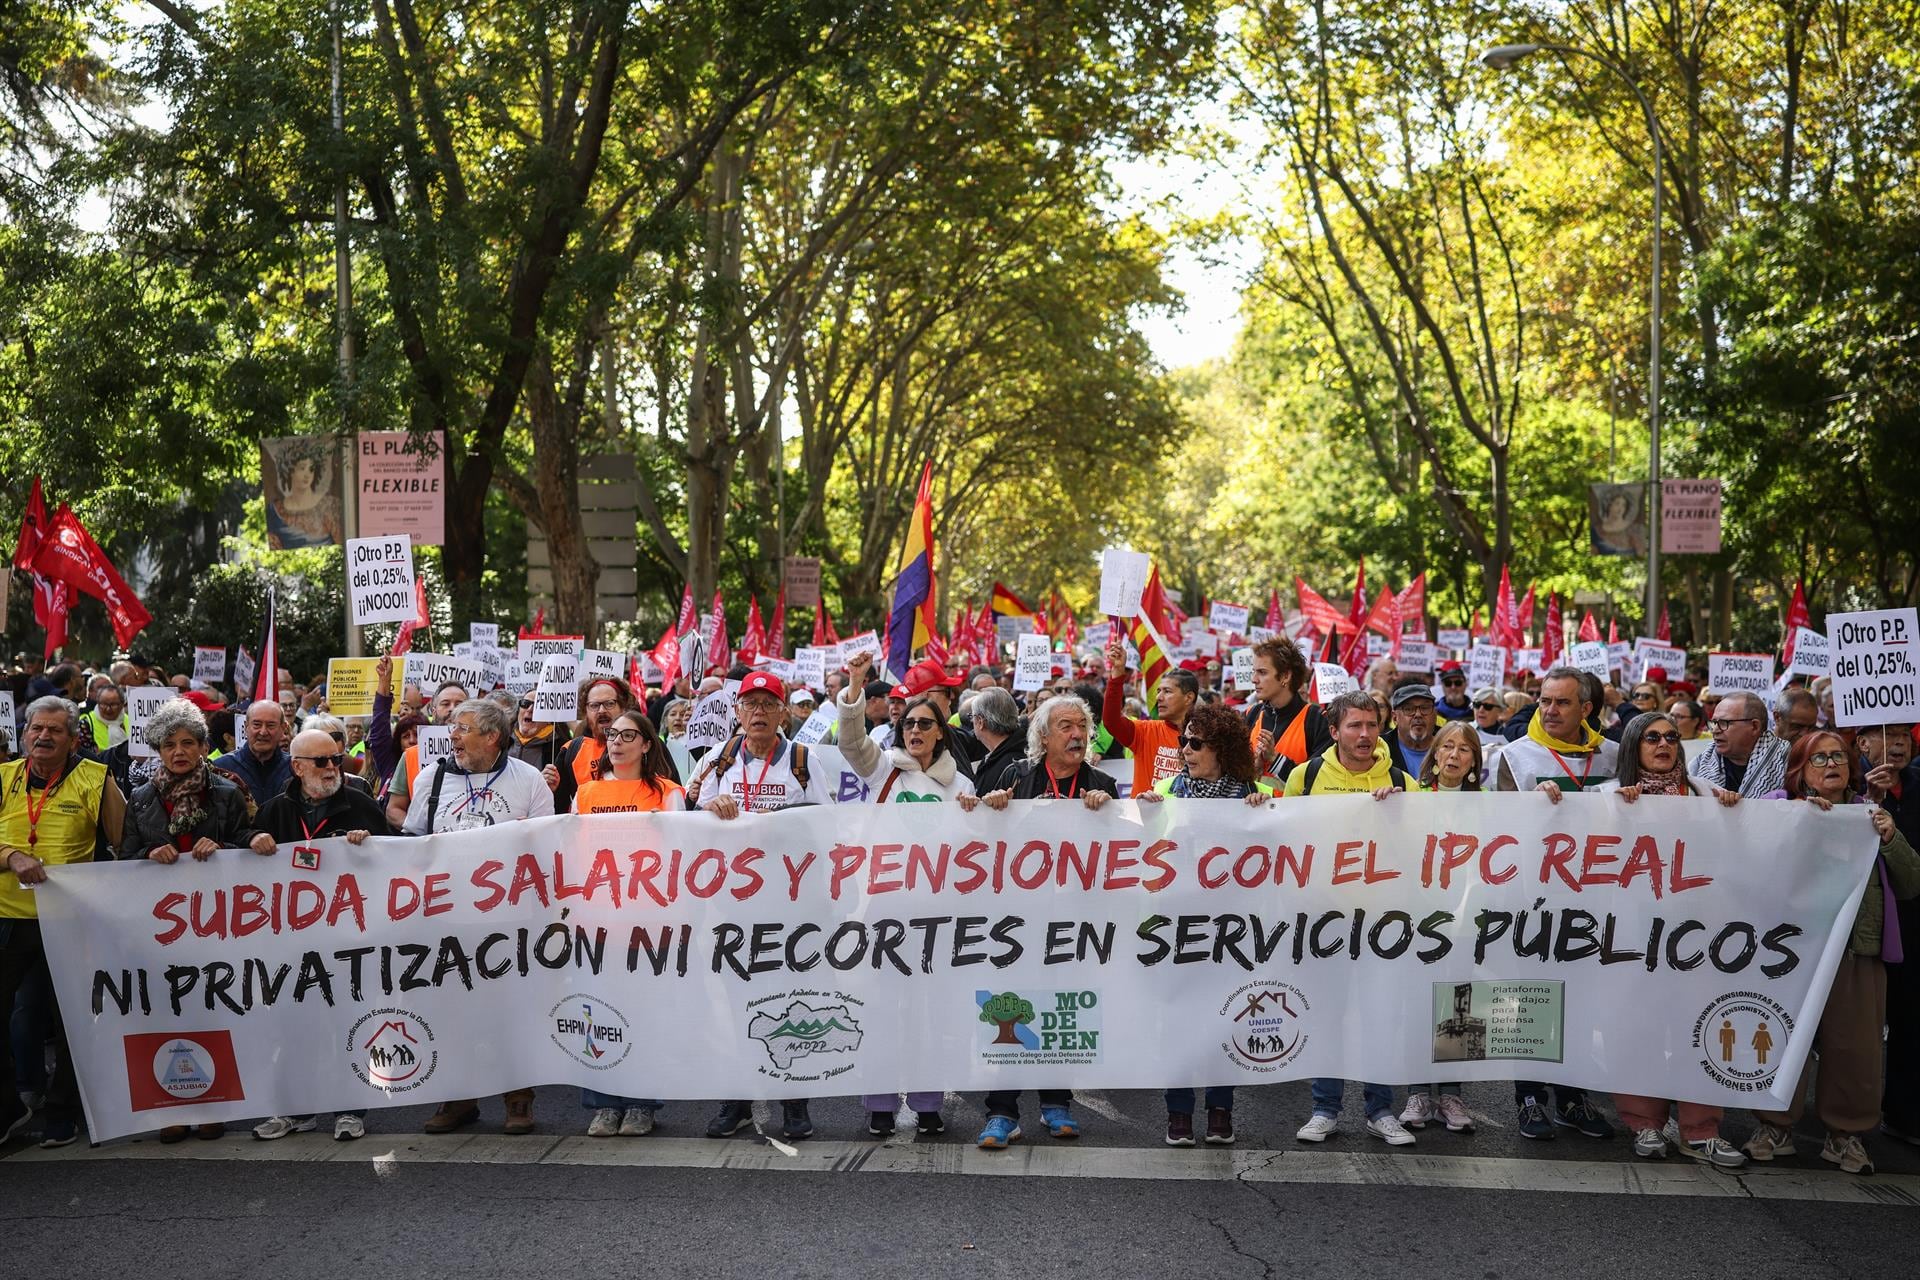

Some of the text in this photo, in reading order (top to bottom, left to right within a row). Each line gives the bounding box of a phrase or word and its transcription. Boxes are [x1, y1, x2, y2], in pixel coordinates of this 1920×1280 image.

[363, 441, 378, 456] EL
[363, 478, 439, 493] FLEXIBLE
[1665, 484, 1719, 495] EL PLANO
[1664, 508, 1717, 520] FLEXIBLE
[353, 542, 405, 567] ¡Otro P.P.
[353, 567, 410, 588] del 0,25%,
[358, 592, 409, 617] ¡¡NOOO!!
[1836, 618, 1909, 651] ¡Otro P.P.
[530, 641, 574, 658] ¡PENSIONES
[595, 655, 614, 672] PAN,
[1721, 658, 1763, 672] ¡PENSIONES
[1836, 650, 1916, 679] del 0,25%,
[423, 663, 482, 690] JUSTICIA!
[541, 665, 575, 686] ¡BLINDAR
[1713, 676, 1769, 691] GARANTIZADAS!
[536, 692, 577, 710] PENSIONES!
[1843, 683, 1916, 716] ¡¡NOOO!!
[688, 721, 728, 740] PENSIONES!
[424, 737, 455, 759] ¡BLINDA
[1155, 757, 1165, 767] DE
[733, 783, 784, 795] ASJUBI40
[591, 805, 638, 814] SINDICATO
[152, 831, 1714, 946] SUBIDA DE SALARIOS Y PENSIONES CON EL IPC REAL
[91, 897, 1804, 1017] NI PRIVATIZACIÓN NI RECORTES EN SERVICIOS PÚBLICOS
[834, 990, 865, 1007] Defensa
[1492, 986, 1551, 994] Plataforma
[1055, 990, 1098, 1011] MO
[1220, 983, 1253, 1016] Coordinadora
[1294, 988, 1310, 1011] Defensa
[1508, 996, 1550, 1005] Badajoz
[1492, 1007, 1515, 1015] para
[1692, 990, 1784, 1048] PLATAFORMA PENSIONISTAS DE
[1720, 1005, 1771, 1021] PENSIONISTAS
[1041, 1011, 1077, 1030] DE
[1248, 1018, 1283, 1026] UNIDAD
[1491, 1016, 1534, 1024] Defensa
[346, 1012, 372, 1052] Coordinadora
[371, 1007, 396, 1017] Estatal
[396, 1008, 410, 1016] por
[415, 1015, 435, 1042] Defensa
[557, 1018, 623, 1043] EHPM MPEH
[1491, 1026, 1504, 1034] de
[785, 1040, 827, 1052] MADPP
[1041, 1031, 1099, 1050] PEN
[1491, 1036, 1545, 1045] Pensiones
[1491, 1046, 1534, 1054] Públicas
[1228, 1052, 1251, 1070] Sistema
[1279, 1061, 1288, 1069] de
[351, 1050, 438, 1093] del Sistema Público de Pensiones
[784, 1072, 820, 1082] Pensiones
[1700, 1059, 1776, 1091] PENSIONES DIG
[167, 1083, 208, 1091] ASJUBI40
